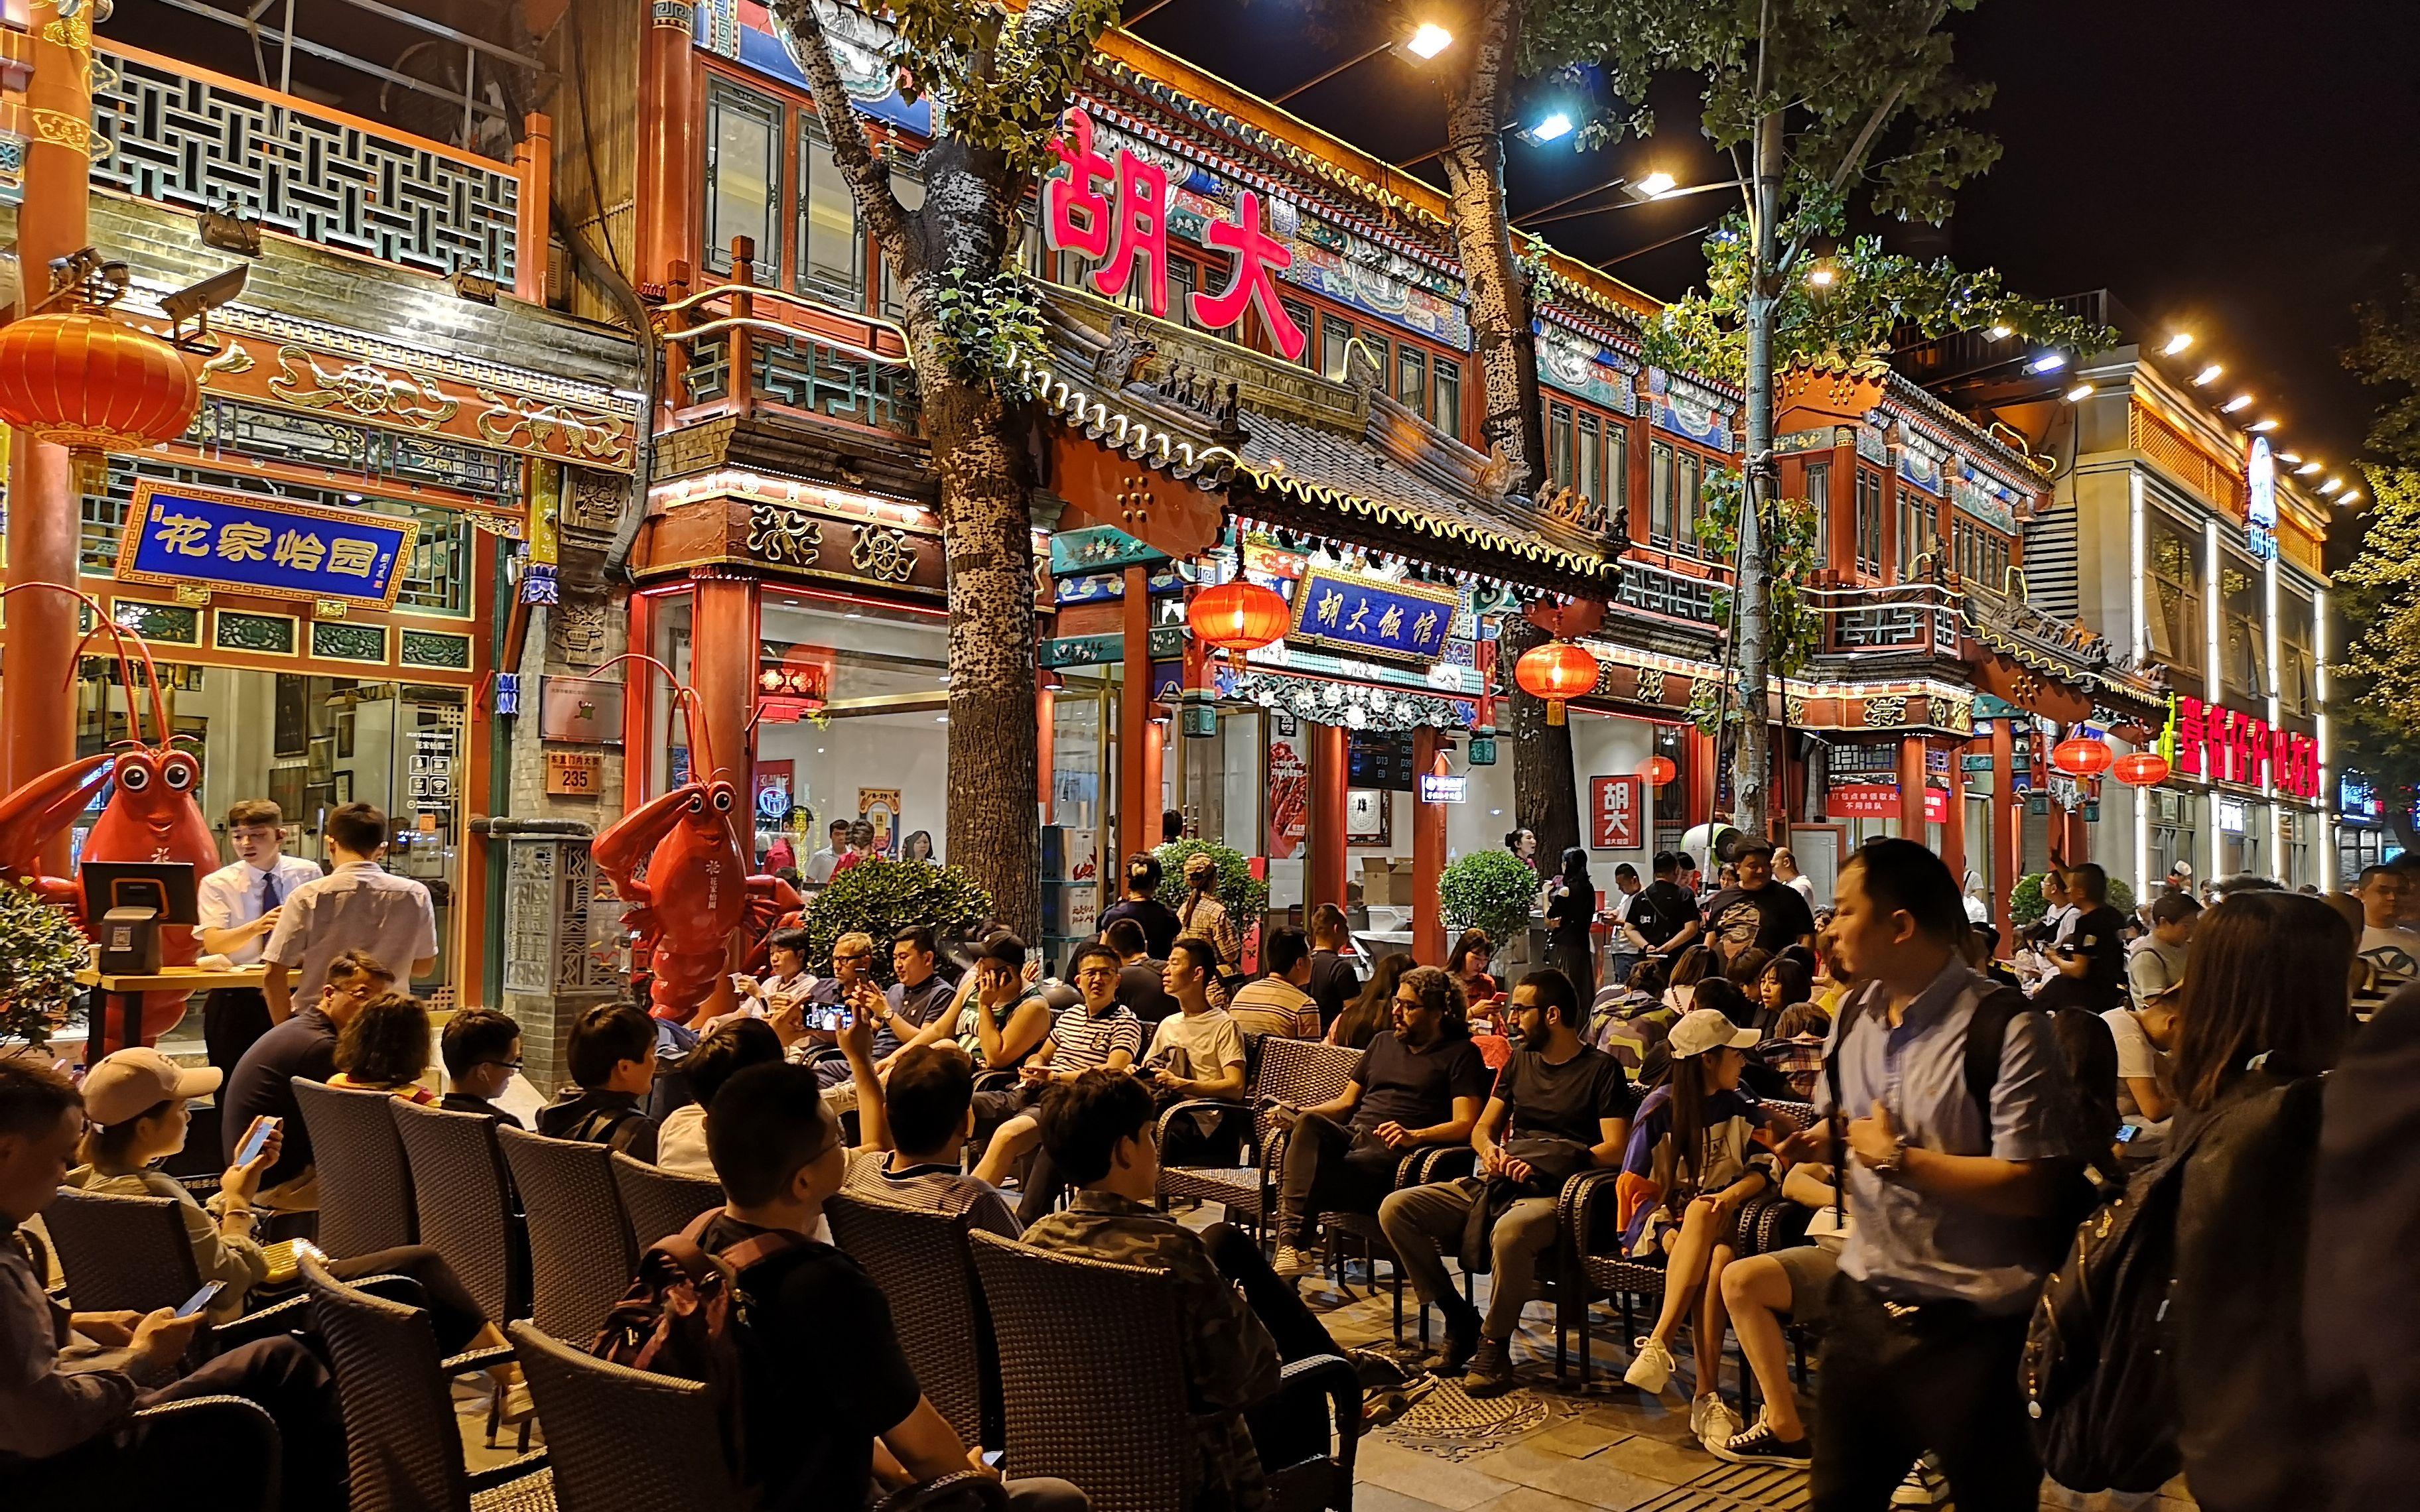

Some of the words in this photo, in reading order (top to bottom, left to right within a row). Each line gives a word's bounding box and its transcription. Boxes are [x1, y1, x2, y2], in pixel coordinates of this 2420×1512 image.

[1044, 106, 1307, 360] 胡大
[155, 513, 379, 578] 花家怡园
[551, 755, 600, 766] 东直门内大街
[563, 770, 588, 787] 235
[1603, 782, 1629, 837] 胡大
